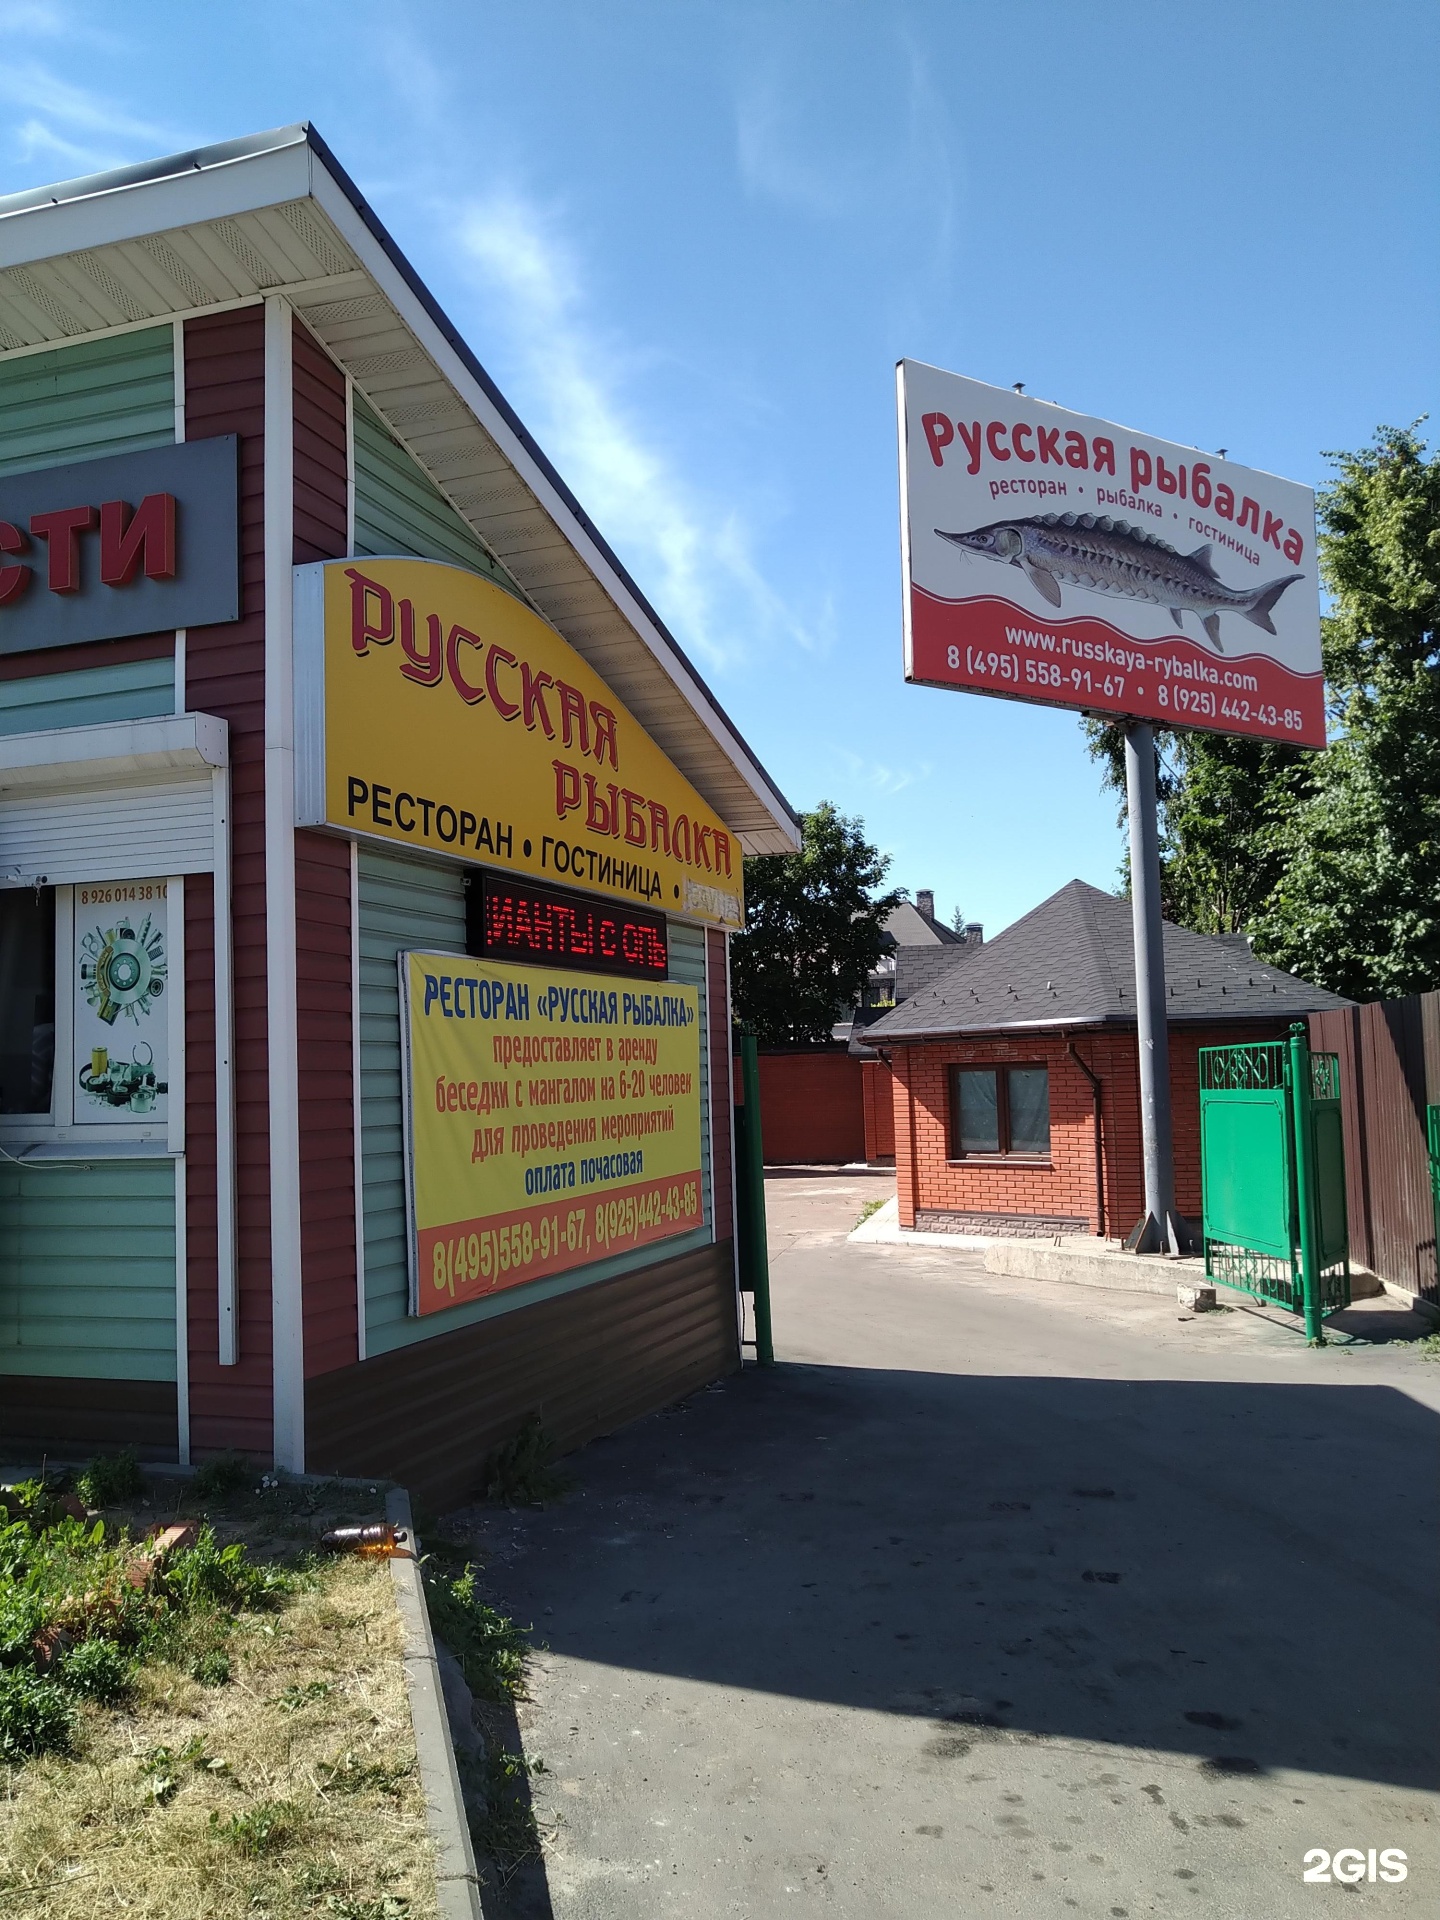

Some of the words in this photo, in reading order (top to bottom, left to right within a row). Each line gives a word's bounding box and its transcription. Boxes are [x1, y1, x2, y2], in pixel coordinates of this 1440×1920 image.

[921, 412, 1116, 476] Русская
[1130, 446, 1305, 566] рыбалка
[989, 478, 1067, 500] ресторан
[1096, 486, 1163, 518] рыбалка
[1188, 516, 1260, 566] гостиница
[344, 568, 618, 771] РУССКАЯ
[946, 645, 960, 669] 8
[966, 645, 1019, 682] (495)
[1024, 659, 1126, 698] 558-91-67
[1158, 684, 1169, 707] 8
[1173, 685, 1216, 718] (925)
[1220, 696, 1304, 731] 442-43-85
[1004, 626, 1259, 693] www.russkaya-rybalka.com
[347, 776, 514, 859] РЕСТОРАН
[541, 836, 662, 901] ГОСТИНИЦА
[551, 759, 733, 878] РЫБАЛКА
[81, 890, 88, 904] 8
[91, 889, 112, 904] 926
[114, 887, 136, 902] 014
[138, 885, 153, 901] 38
[424, 974, 530, 1021] РЕСТОРАН
[537, 986, 618, 1025] «РУССКАЯ
[622, 992, 694, 1027] РЫБАЛКА»
[492, 1035, 602, 1069] предоставляет
[606, 1037, 614, 1062] в
[618, 1037, 658, 1066] аренду
[435, 1075, 509, 1115] беседки
[515, 1079, 523, 1108] с
[528, 1077, 596, 1106] мангалом
[600, 1076, 615, 1100] на
[619, 1069, 645, 1100] 6-20
[649, 1072, 692, 1097] человек
[471, 1126, 505, 1164] для
[511, 1117, 597, 1158] проведения
[601, 1104, 674, 1144] мероприятий
[525, 1161, 576, 1196] оплата
[580, 1150, 643, 1186] почасовая
[432, 1208, 591, 1298] 8(495)558-91-67,
[595, 1181, 698, 1250] 8(925)442-43-85
